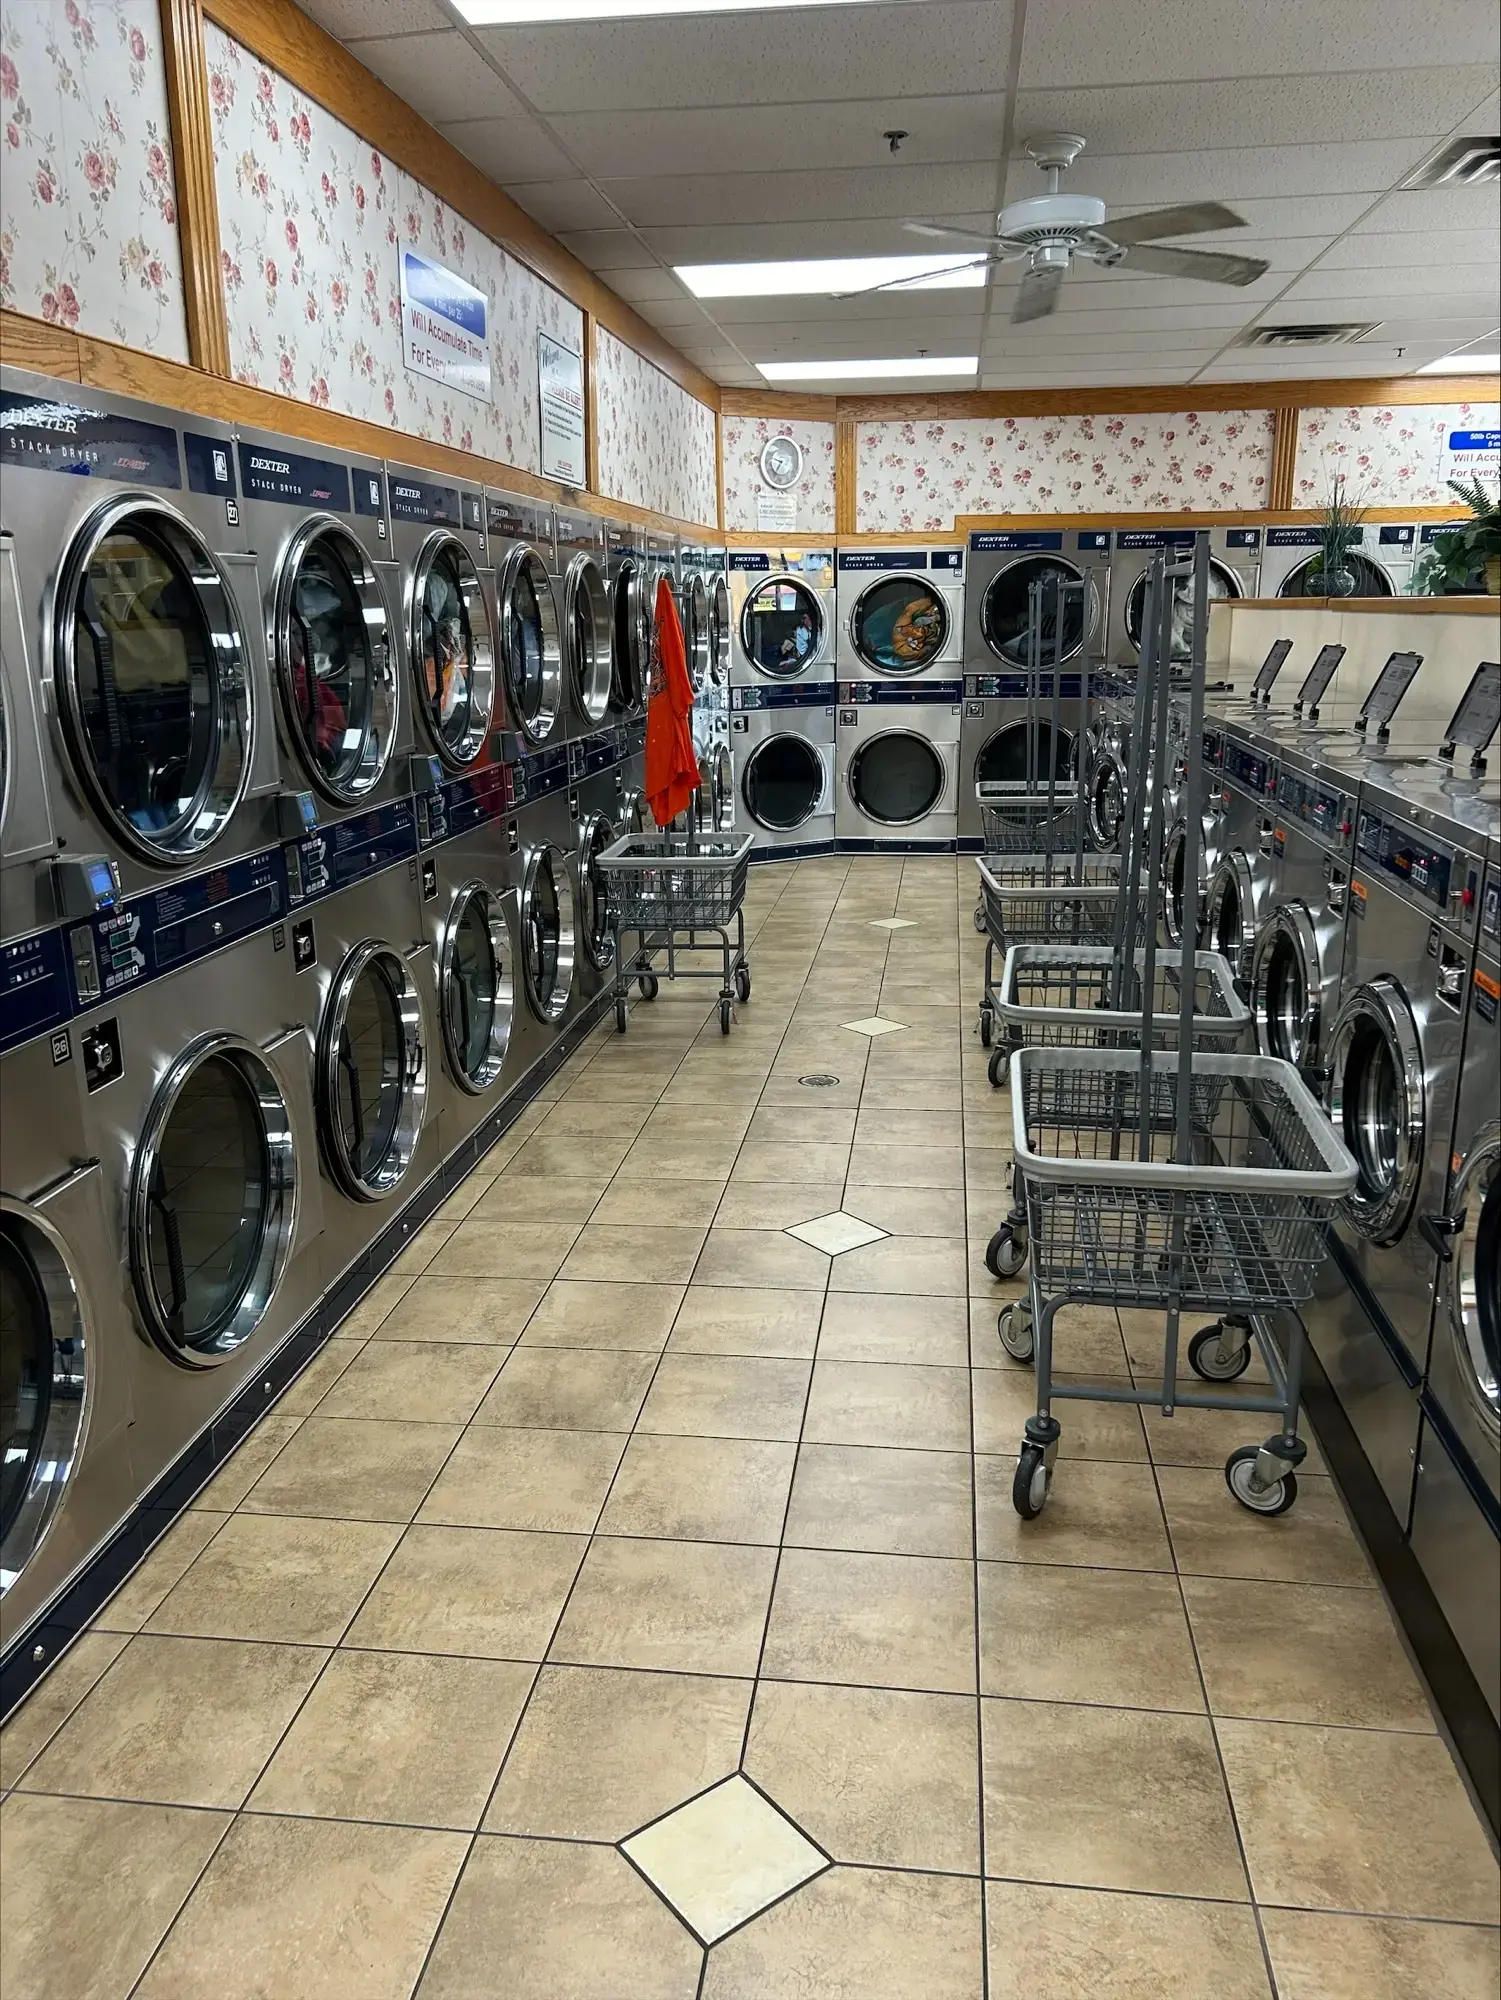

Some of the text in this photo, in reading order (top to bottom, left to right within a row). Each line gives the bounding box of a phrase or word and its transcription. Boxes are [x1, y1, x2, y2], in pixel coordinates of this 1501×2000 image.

[411, 308, 483, 362] Will Accumulate Time
[411, 342, 446, 379] For Every
[10, 437, 99, 462] STACK DRYER
[1453, 453, 1474, 462] Will
[250, 457, 290, 474] DEXTER
[1450, 468, 1500, 479] For Every
[251, 478, 302, 494] STACK DRYER
[395, 486, 421, 499] DEXTER
[395, 503, 412, 513] STACK
[413, 505, 429, 516] DRYER
[54, 1039, 67, 1055] 26
